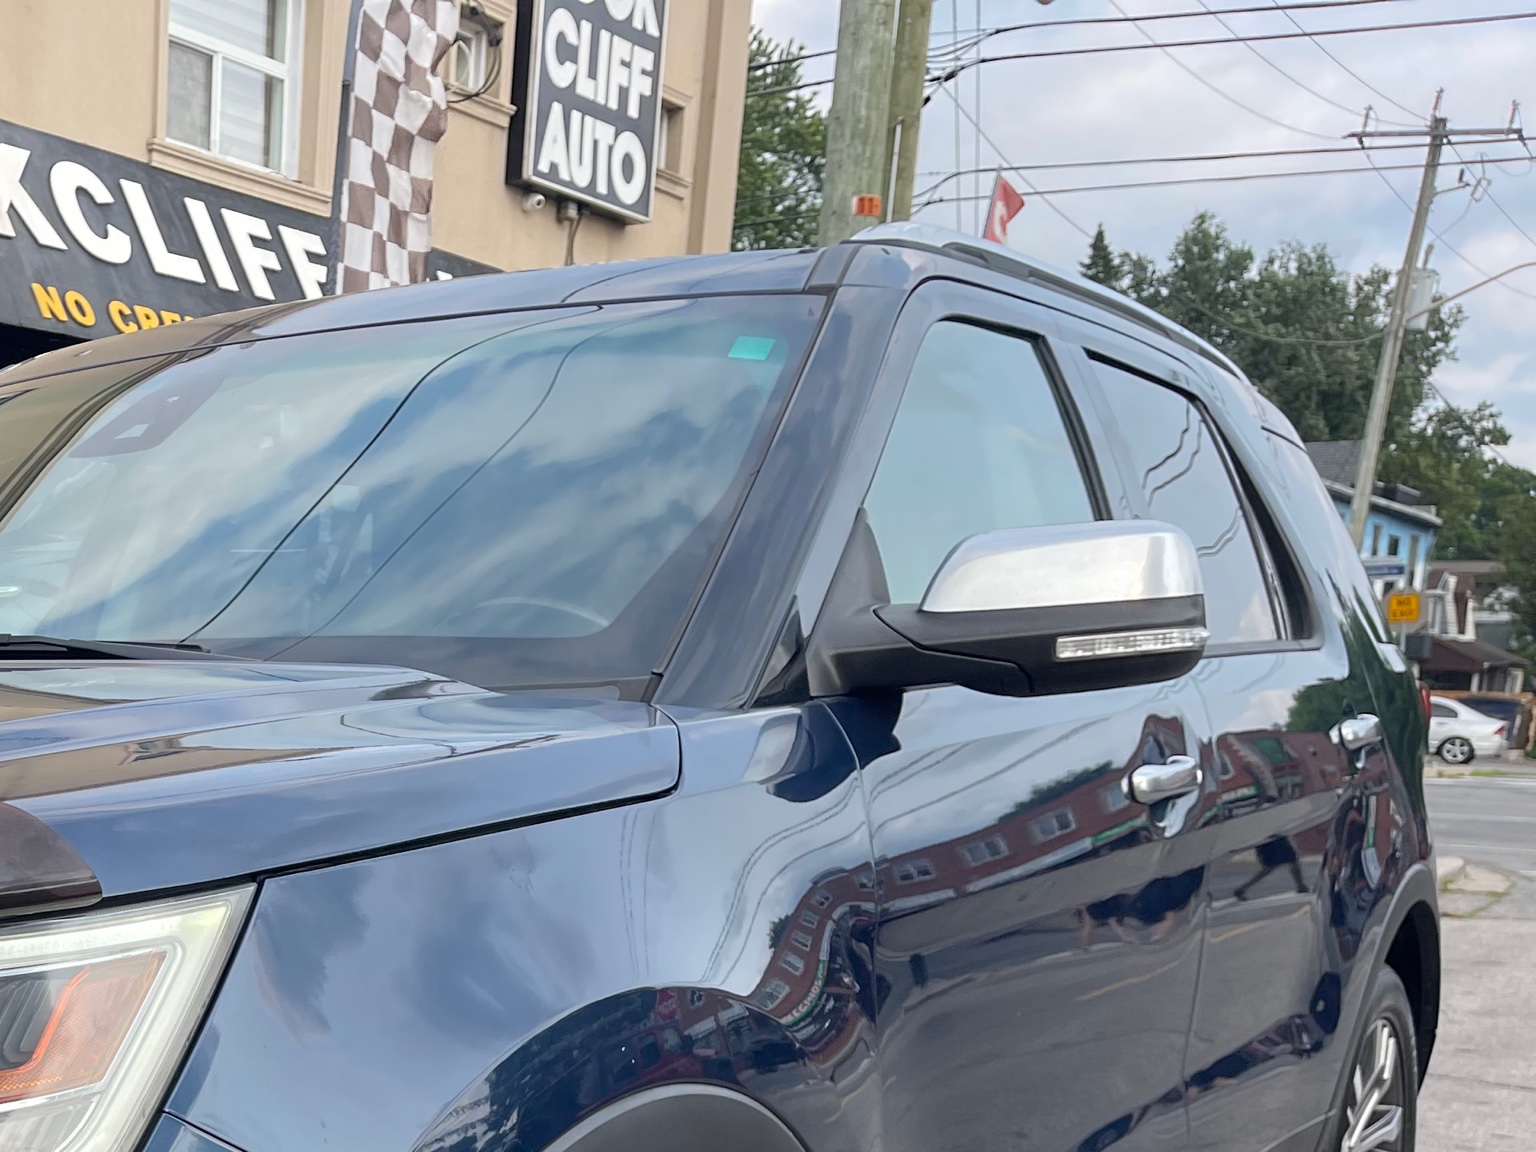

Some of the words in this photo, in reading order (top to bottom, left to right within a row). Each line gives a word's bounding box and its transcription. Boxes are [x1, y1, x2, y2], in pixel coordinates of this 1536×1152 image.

[544, 7, 655, 120] CLIFF
[537, 101, 647, 206] AUTO
[31, 282, 96, 327] NO
